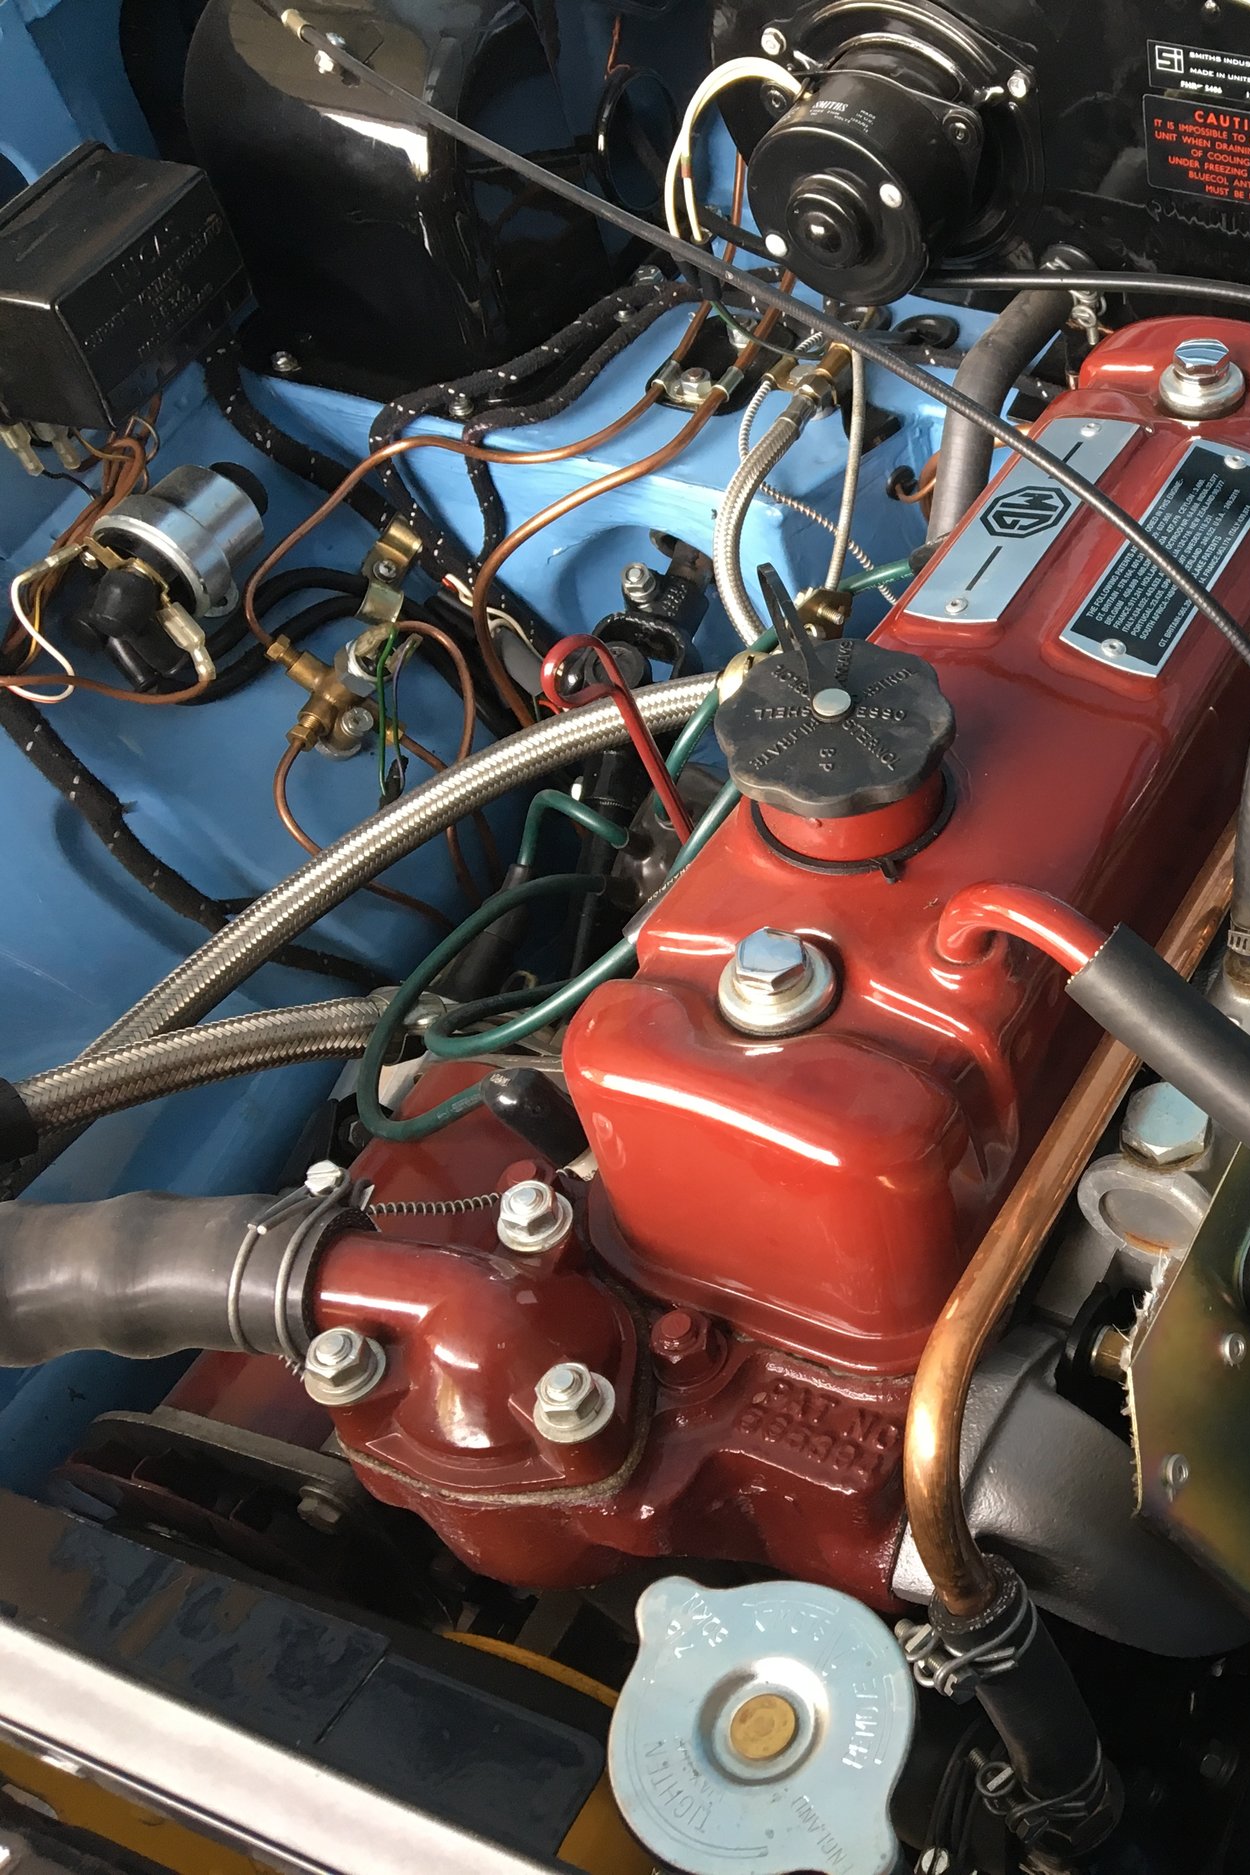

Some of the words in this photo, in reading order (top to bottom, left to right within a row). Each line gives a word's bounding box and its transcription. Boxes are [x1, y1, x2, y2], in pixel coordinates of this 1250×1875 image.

[1189, 52, 1222, 63] SMITHS
[1190, 67, 1214, 78] MADE
[1216, 71, 1225, 79] IN
[815, 101, 848, 111] SMITHS
[1154, 119, 1163, 127] IT
[1167, 121, 1175, 130] IS
[1179, 123, 1228, 140] IMPOSSIBLE
[1232, 132, 1246, 143] TO
[1155, 130, 1177, 141] UNIT
[1182, 135, 1211, 148] WHEN
[1168, 156, 1200, 169] UNDER
[1204, 163, 1248, 178] FREEZING
[1191, 149, 1203, 158] OF
[1207, 151, 1250, 167] COOLING
[1188, 171, 1229, 186] BLUECOL
[1205, 185, 1230, 196] MUST
[1234, 190, 1245, 199] BE
[991, 490, 1060, 531] MG
[1201, 534, 1222, 561] PATENTS
[1085, 604, 1098, 618] THE
[1093, 573, 1119, 607] FOLLOWING
[1114, 551, 1134, 576] PATENTS
[1159, 497, 1170, 511] THIS
[1139, 619, 1156, 640] SOUTH
[754, 705, 811, 721] SHELL
[855, 706, 905, 721] ESSO
[644, 1740, 712, 1834] TIGHTEN
